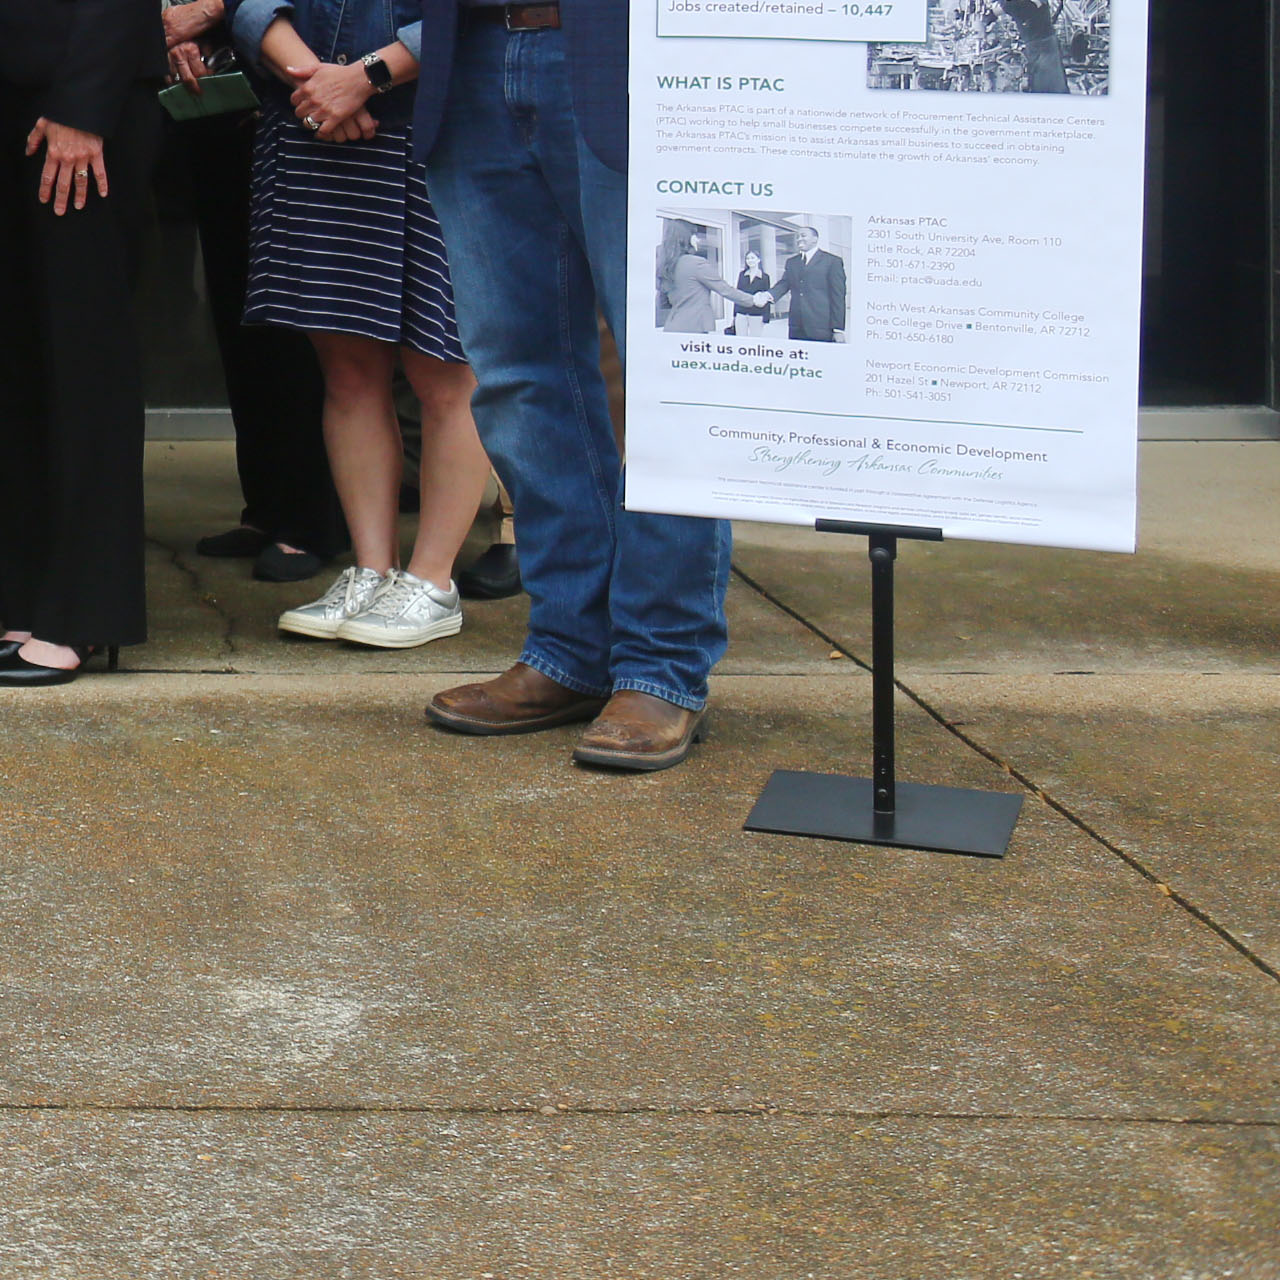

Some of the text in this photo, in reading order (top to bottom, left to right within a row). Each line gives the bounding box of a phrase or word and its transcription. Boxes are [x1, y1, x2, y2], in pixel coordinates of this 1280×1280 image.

[668, 0, 892, 17] Jobs created/retained 10,447
[656, 76, 784, 91] WHAT IS PTAC
[656, 180, 773, 196] CONTACT US
[868, 215, 946, 227] Arkansas PTAC
[867, 229, 1061, 246] 2301 South University Ave, Room 110
[867, 244, 975, 257] Little Rock, AR 72204
[886, 259, 954, 270] 501-671-2390
[901, 276, 981, 286] ptac@uada.edu
[867, 301, 1084, 323] North West Arkansas Community College
[866, 315, 1089, 337] One College Drive Bentonville, AR 72712
[885, 331, 953, 343] 501-650-6180
[680, 340, 808, 360] visit us online at:
[671, 359, 822, 377] uaex.uada.edu/ptac
[866, 359, 1109, 382] Newport Economic Development Commission
[865, 373, 1041, 393] 201 Hazel St Newport, AR 72112
[708, 426, 1047, 462] Community, Professional & Economic Development
[746, 446, 1003, 479] Strengthening Arkansas Communities
